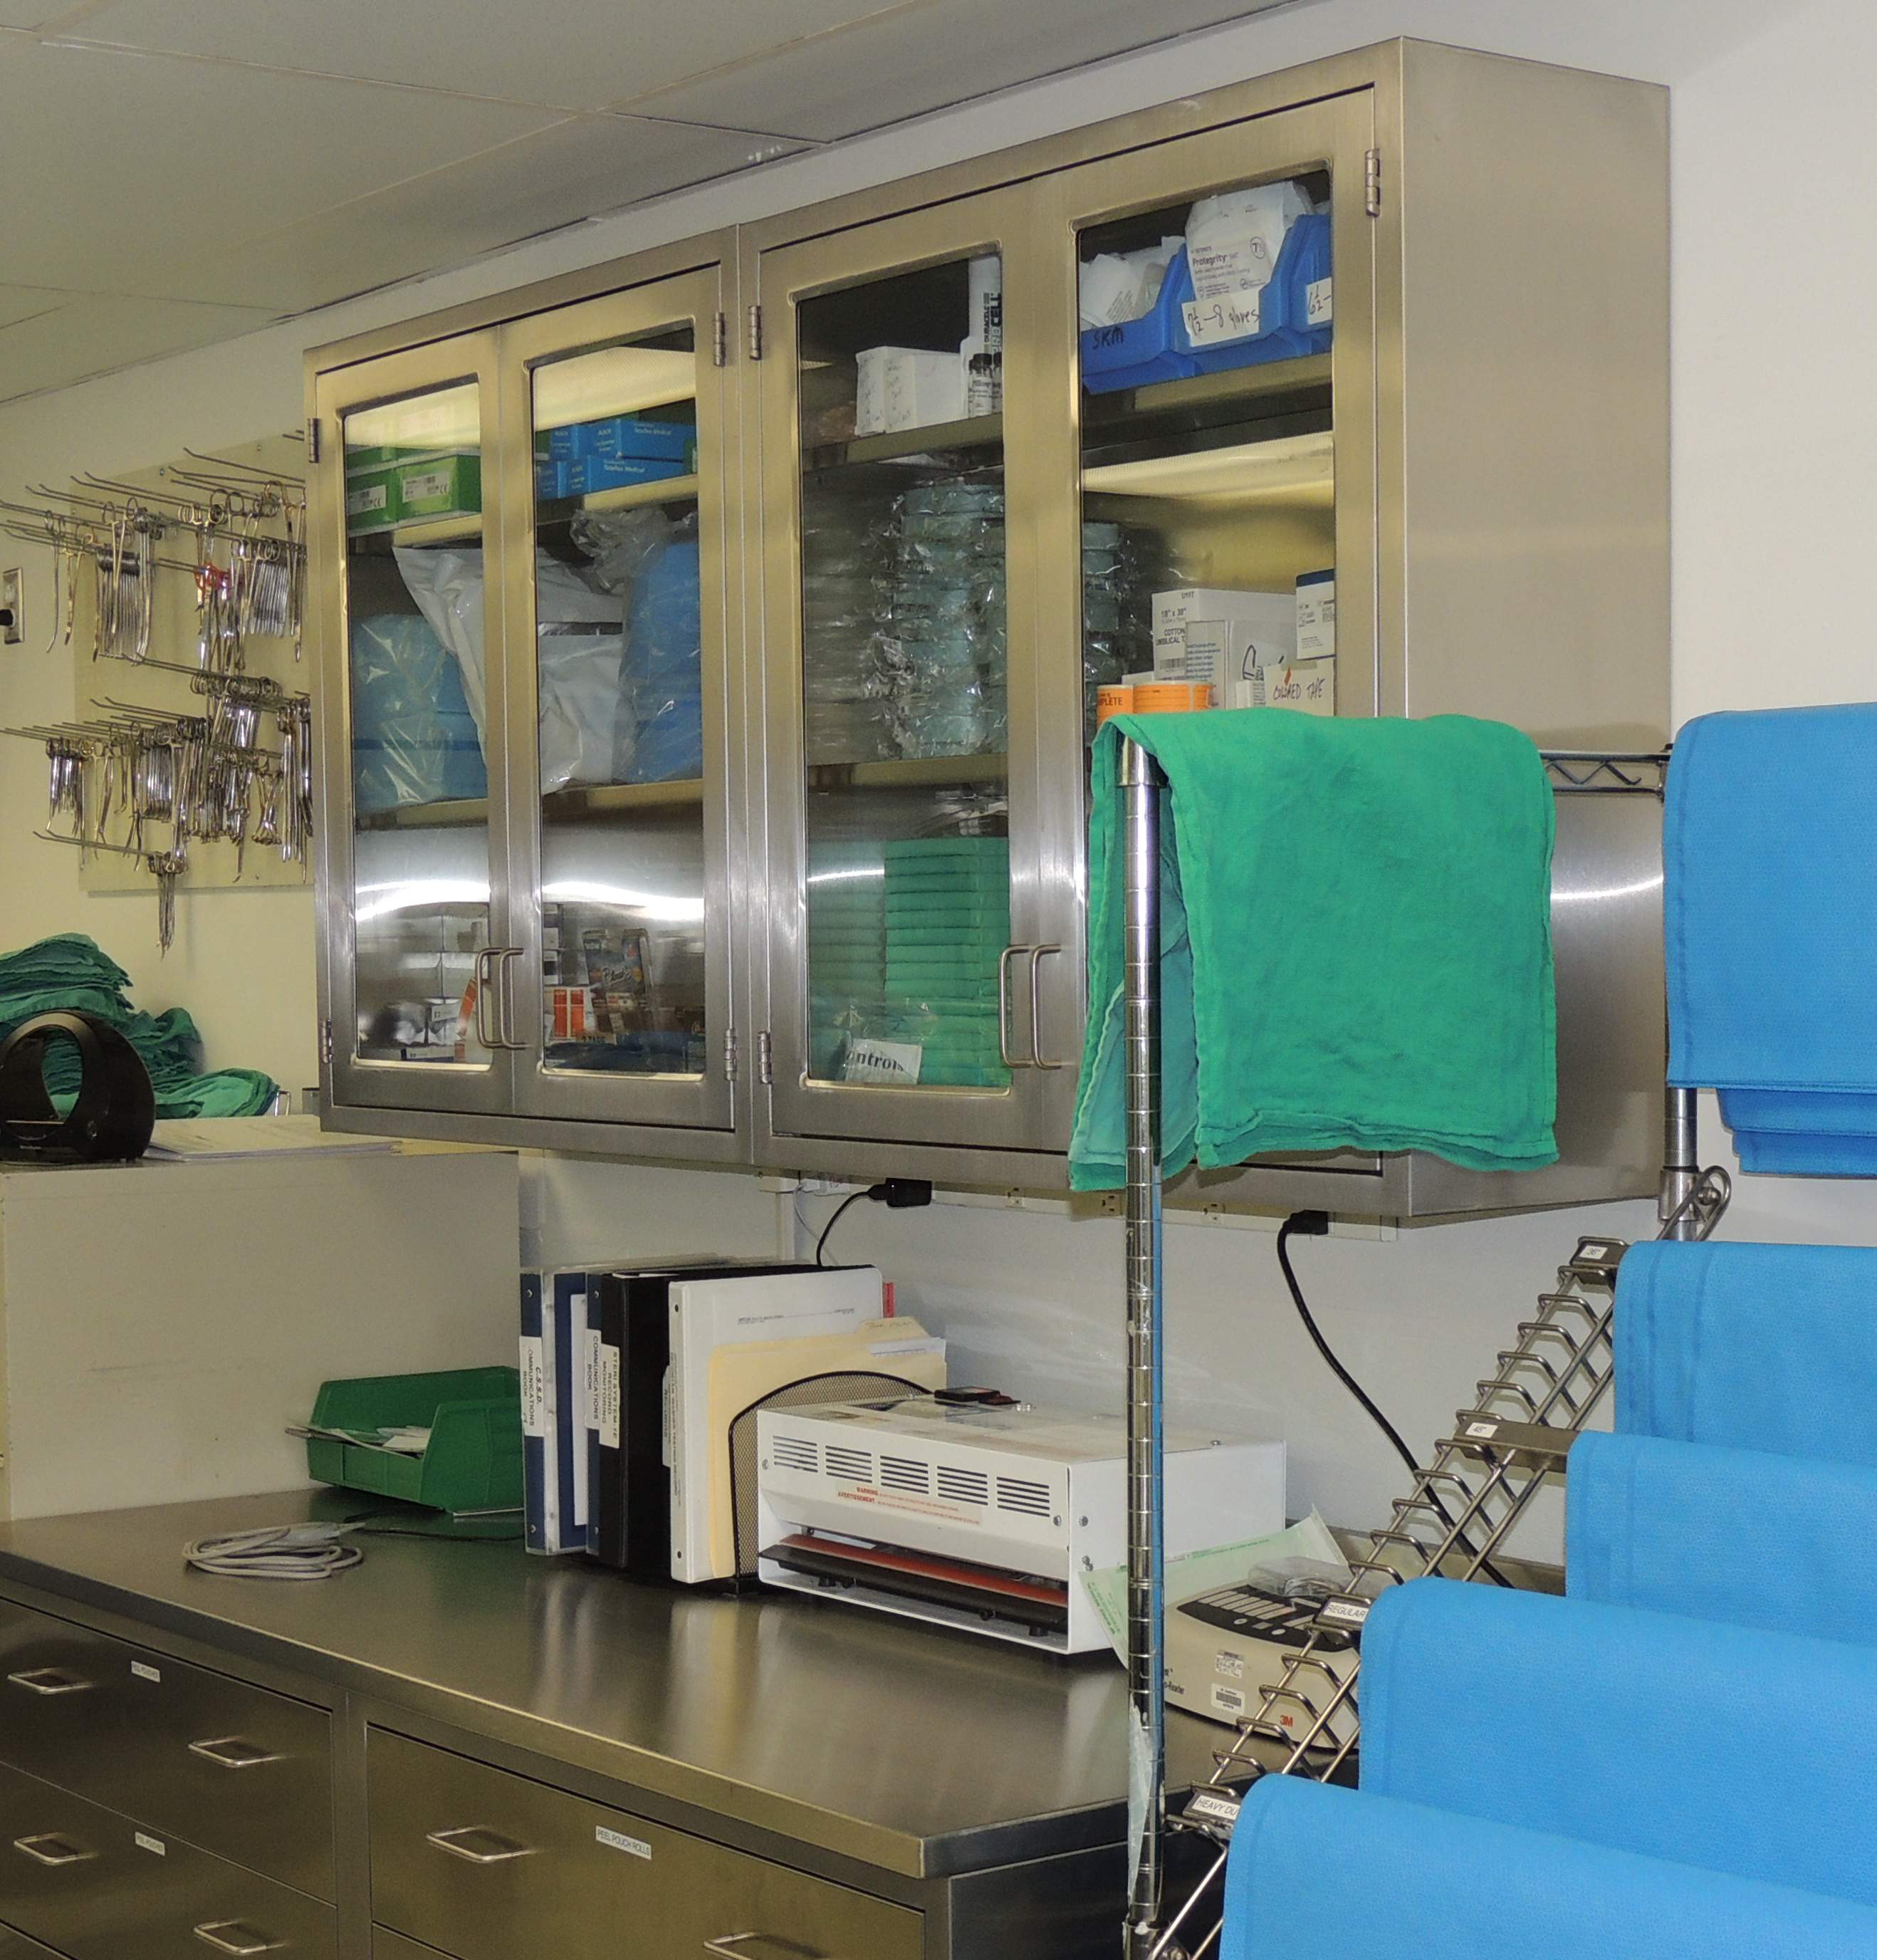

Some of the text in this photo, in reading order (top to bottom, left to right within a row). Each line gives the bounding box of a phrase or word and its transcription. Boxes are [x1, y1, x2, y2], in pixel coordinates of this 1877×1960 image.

[857, 1486, 878, 1496] WARNING
[1327, 1605, 1366, 1618] REGULAR
[1280, 1714, 1293, 1727] 3M
[1197, 1798, 1238, 1815] HEAVY DU
